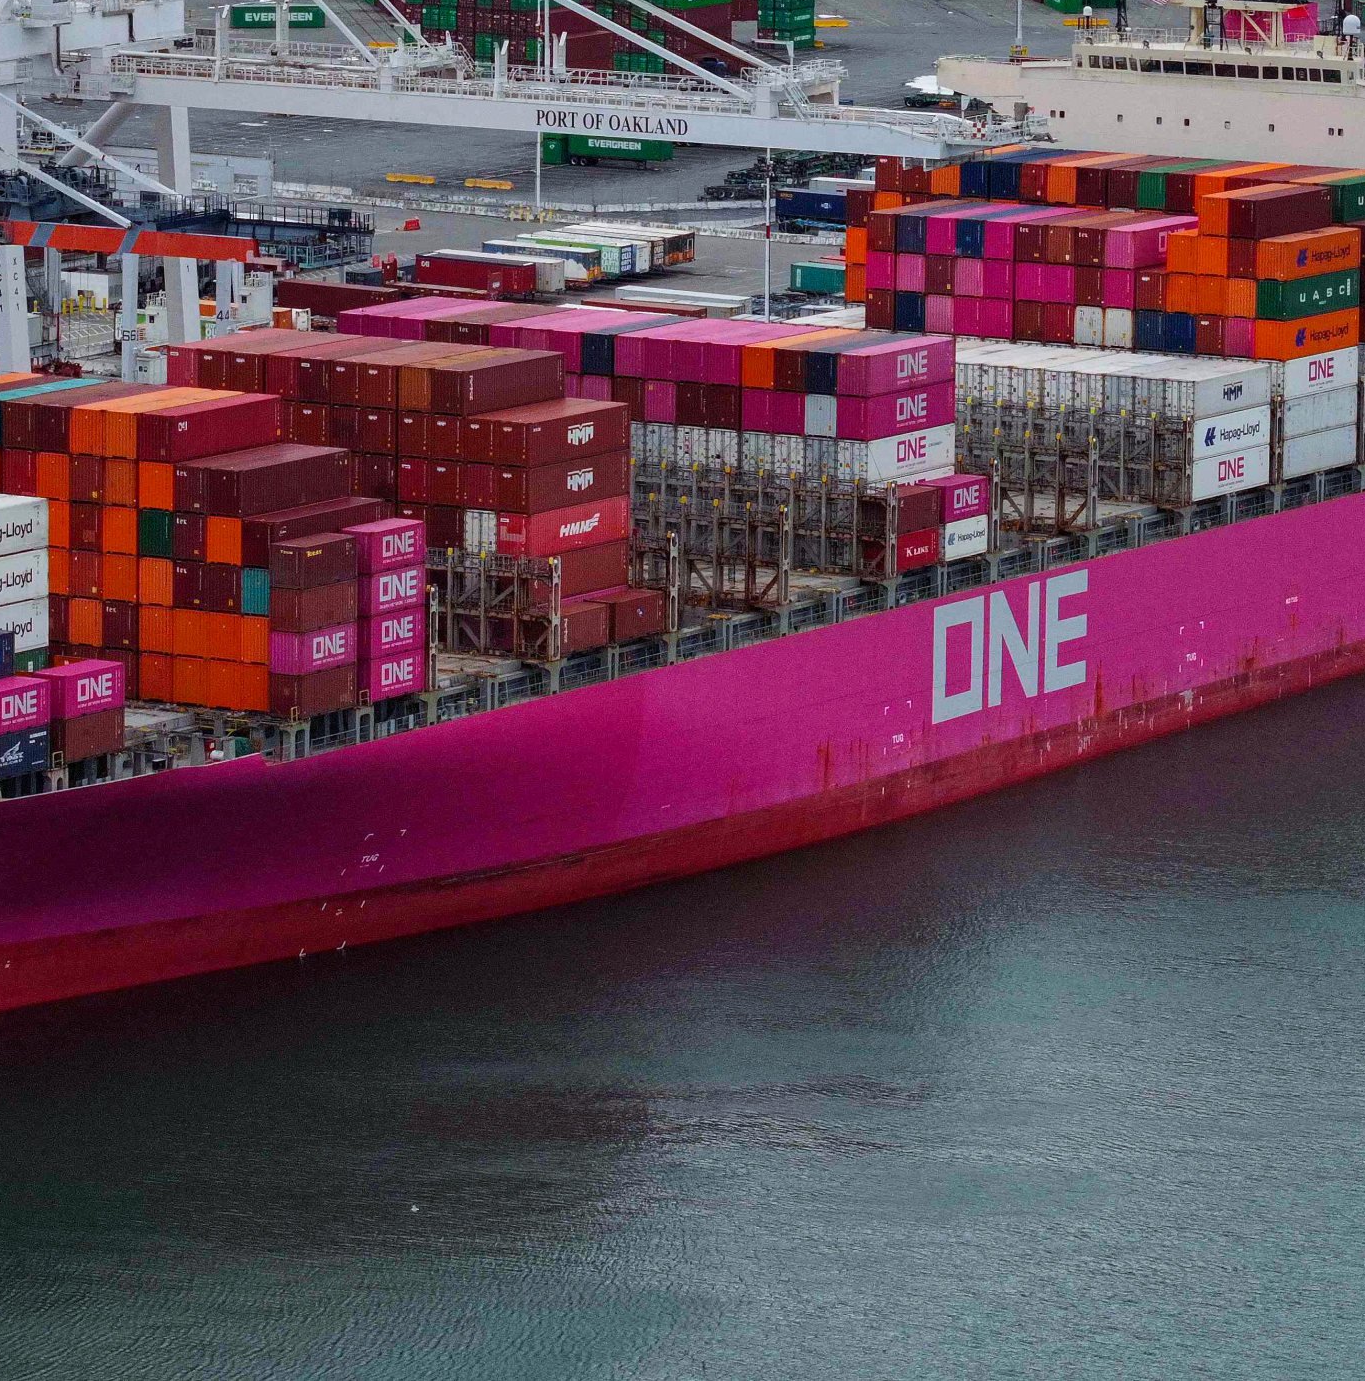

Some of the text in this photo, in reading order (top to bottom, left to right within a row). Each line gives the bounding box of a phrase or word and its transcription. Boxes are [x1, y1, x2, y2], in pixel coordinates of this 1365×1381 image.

[536, 109, 688, 136] PORT OF OAKLAND
[588, 138, 642, 151] EVERGREEN
[1311, 243, 1351, 263] Hapag-Lloyd
[12, 257, 21, 312] XC41
[216, 309, 230, 321] 44
[1310, 322, 1349, 342] Hapag-Lloyd
[897, 350, 928, 379] ONE
[1308, 357, 1334, 382] ONE
[1223, 381, 1242, 401] HMM
[897, 393, 927, 422] ONE
[568, 422, 594, 446] HMM
[1220, 420, 1260, 442] Hapag-Lloyd
[897, 436, 926, 463] ONE
[567, 468, 593, 492] HMM
[1218, 455, 1245, 483] ONE
[954, 485, 980, 509] ONE
[383, 530, 415, 558] ONE
[957, 529, 986, 543] Hapag-Lloyd
[379, 569, 418, 602] ONE
[382, 616, 413, 643] ONE
[313, 631, 346, 661] ONE
[932, 569, 1088, 725] ONE
[382, 659, 413, 686] ONE
[77, 673, 113, 703] ONE
[1, 690, 38, 720] ONE
[892, 733, 904, 743] TUG
[362, 854, 380, 863] TUG
